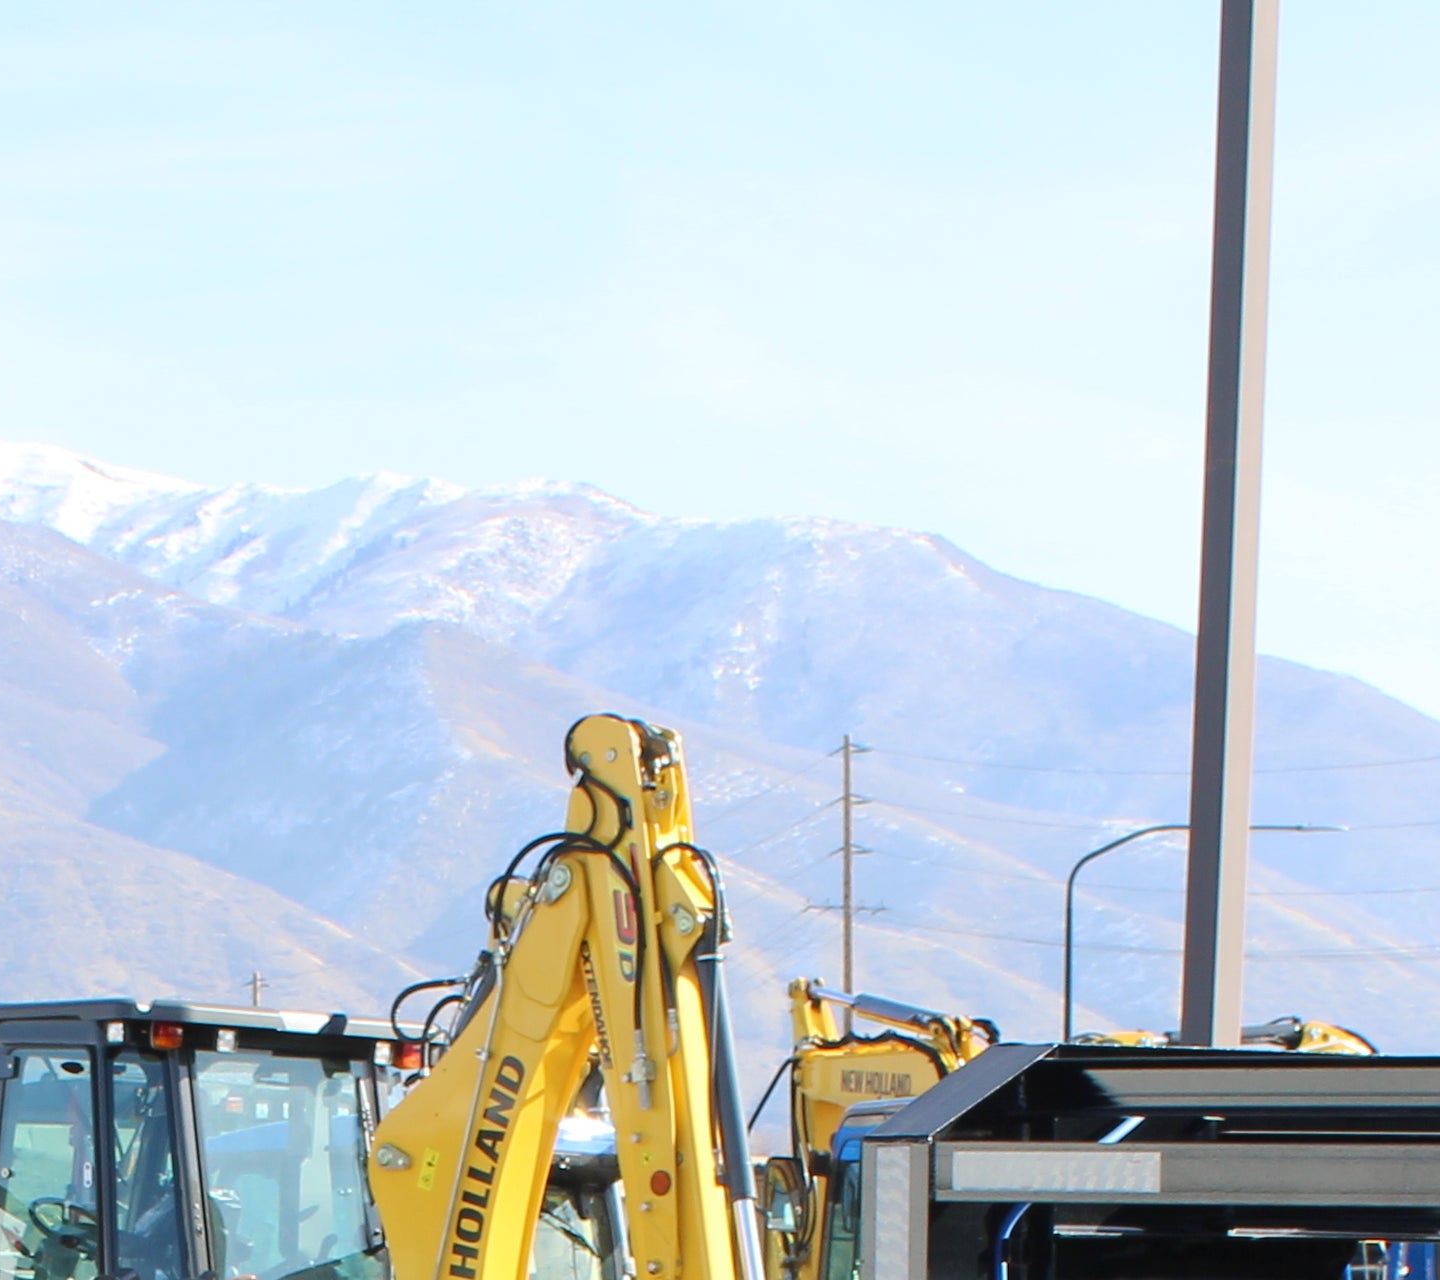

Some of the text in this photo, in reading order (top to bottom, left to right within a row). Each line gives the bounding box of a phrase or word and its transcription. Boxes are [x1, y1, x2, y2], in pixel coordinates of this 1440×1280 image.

[840, 1069, 913, 1097] NEW HOLLAND
[449, 1054, 526, 1280] HOLLAND
